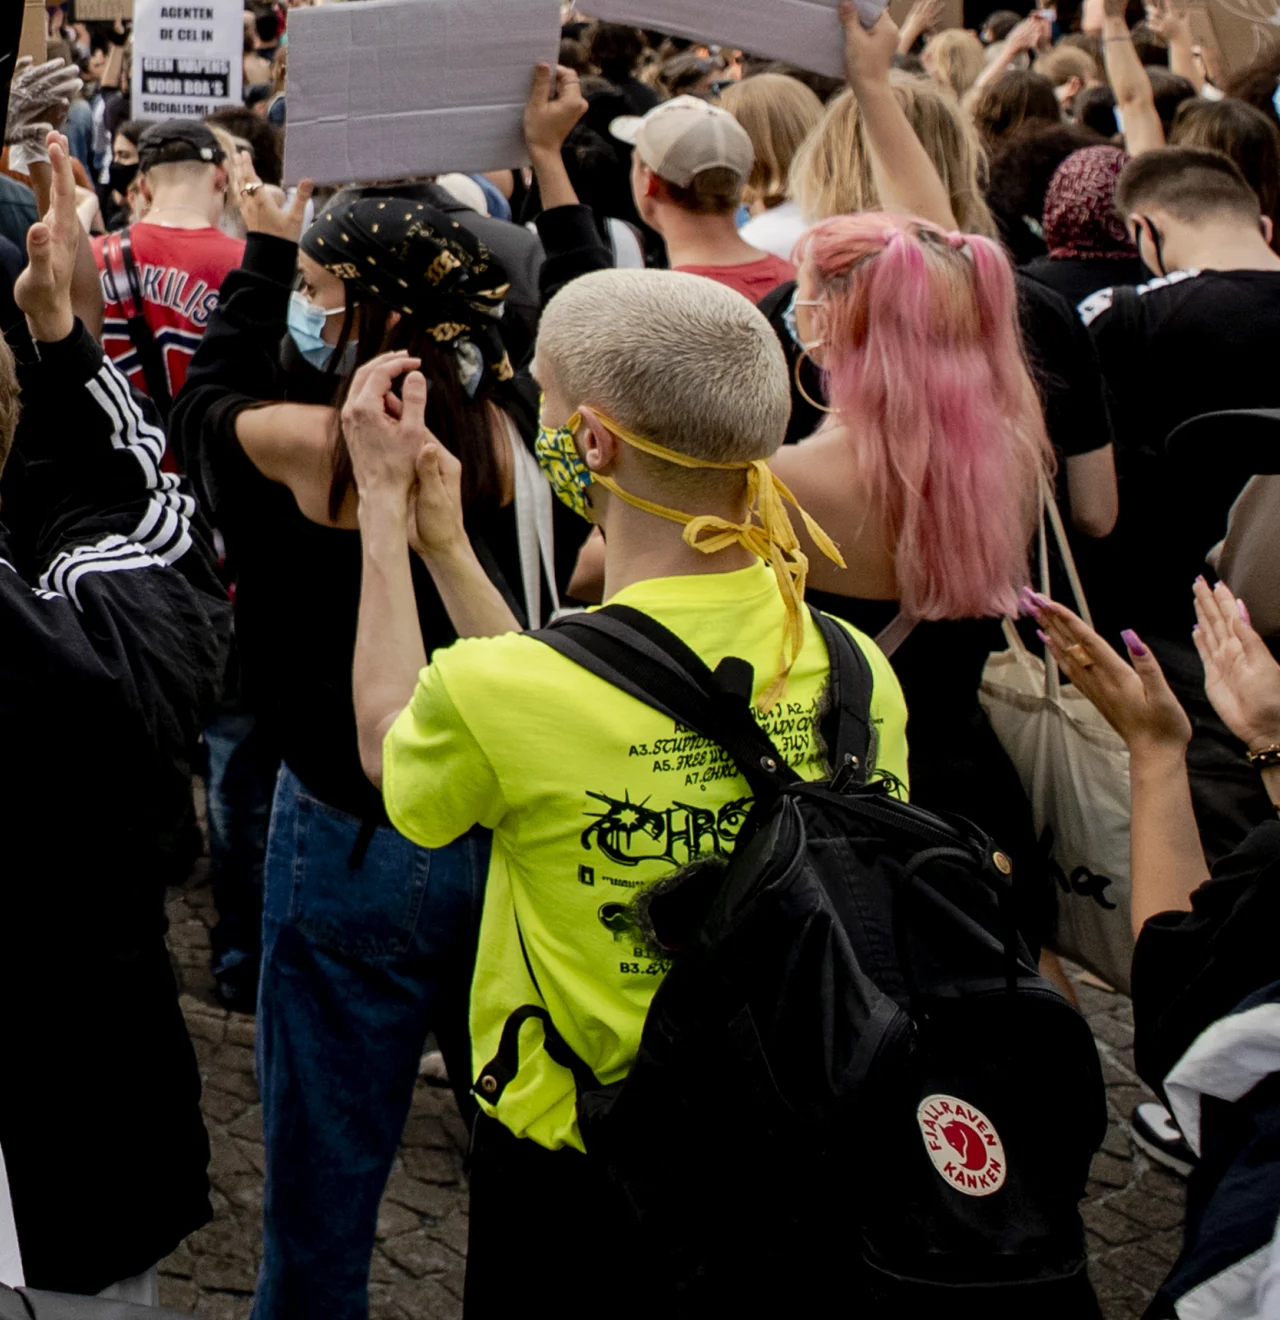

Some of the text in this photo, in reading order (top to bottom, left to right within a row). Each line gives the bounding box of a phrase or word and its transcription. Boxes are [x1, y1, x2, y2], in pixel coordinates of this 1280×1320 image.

[160, 6, 214, 20] AGENTEN
[159, 28, 213, 41] DE CEL IN
[147, 77, 182, 94] VOOR
